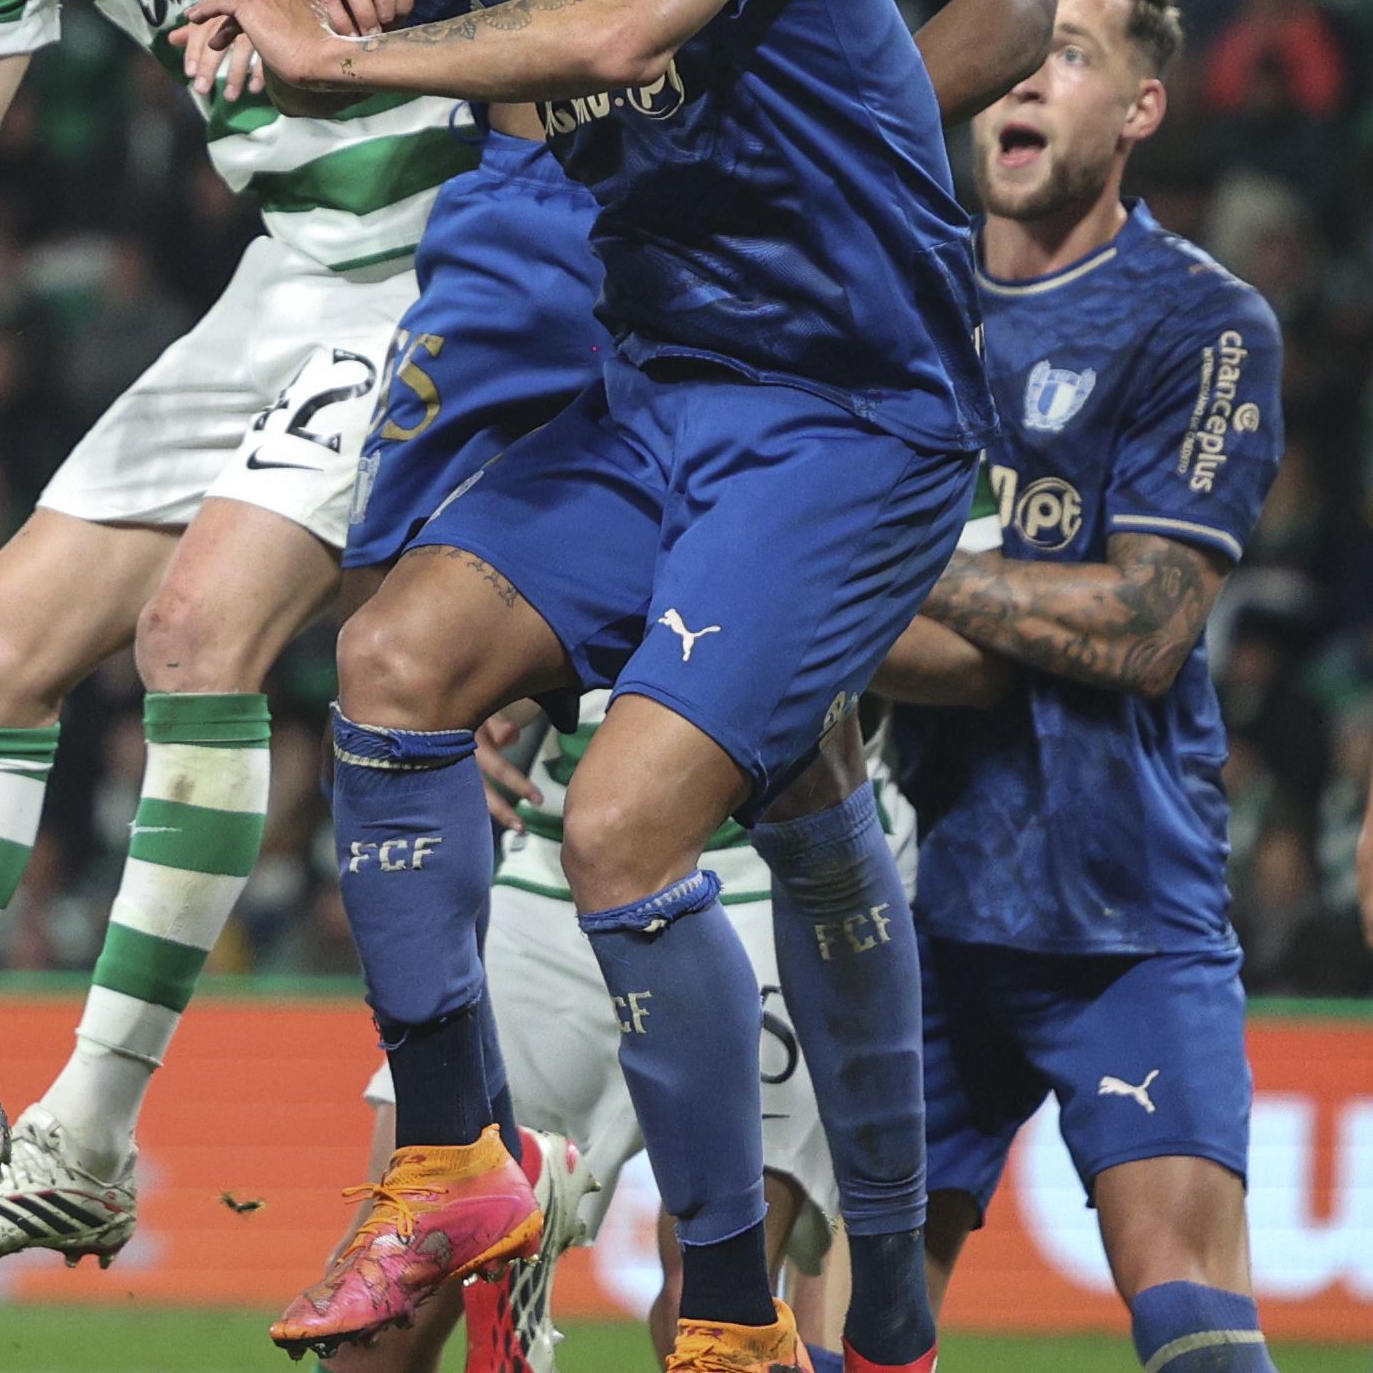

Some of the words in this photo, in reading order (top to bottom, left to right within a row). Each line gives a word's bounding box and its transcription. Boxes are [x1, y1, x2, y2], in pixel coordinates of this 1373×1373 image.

[1189, 329, 1249, 493] chanceplus
[349, 836, 443, 874] FCF
[814, 901, 893, 961] FCF
